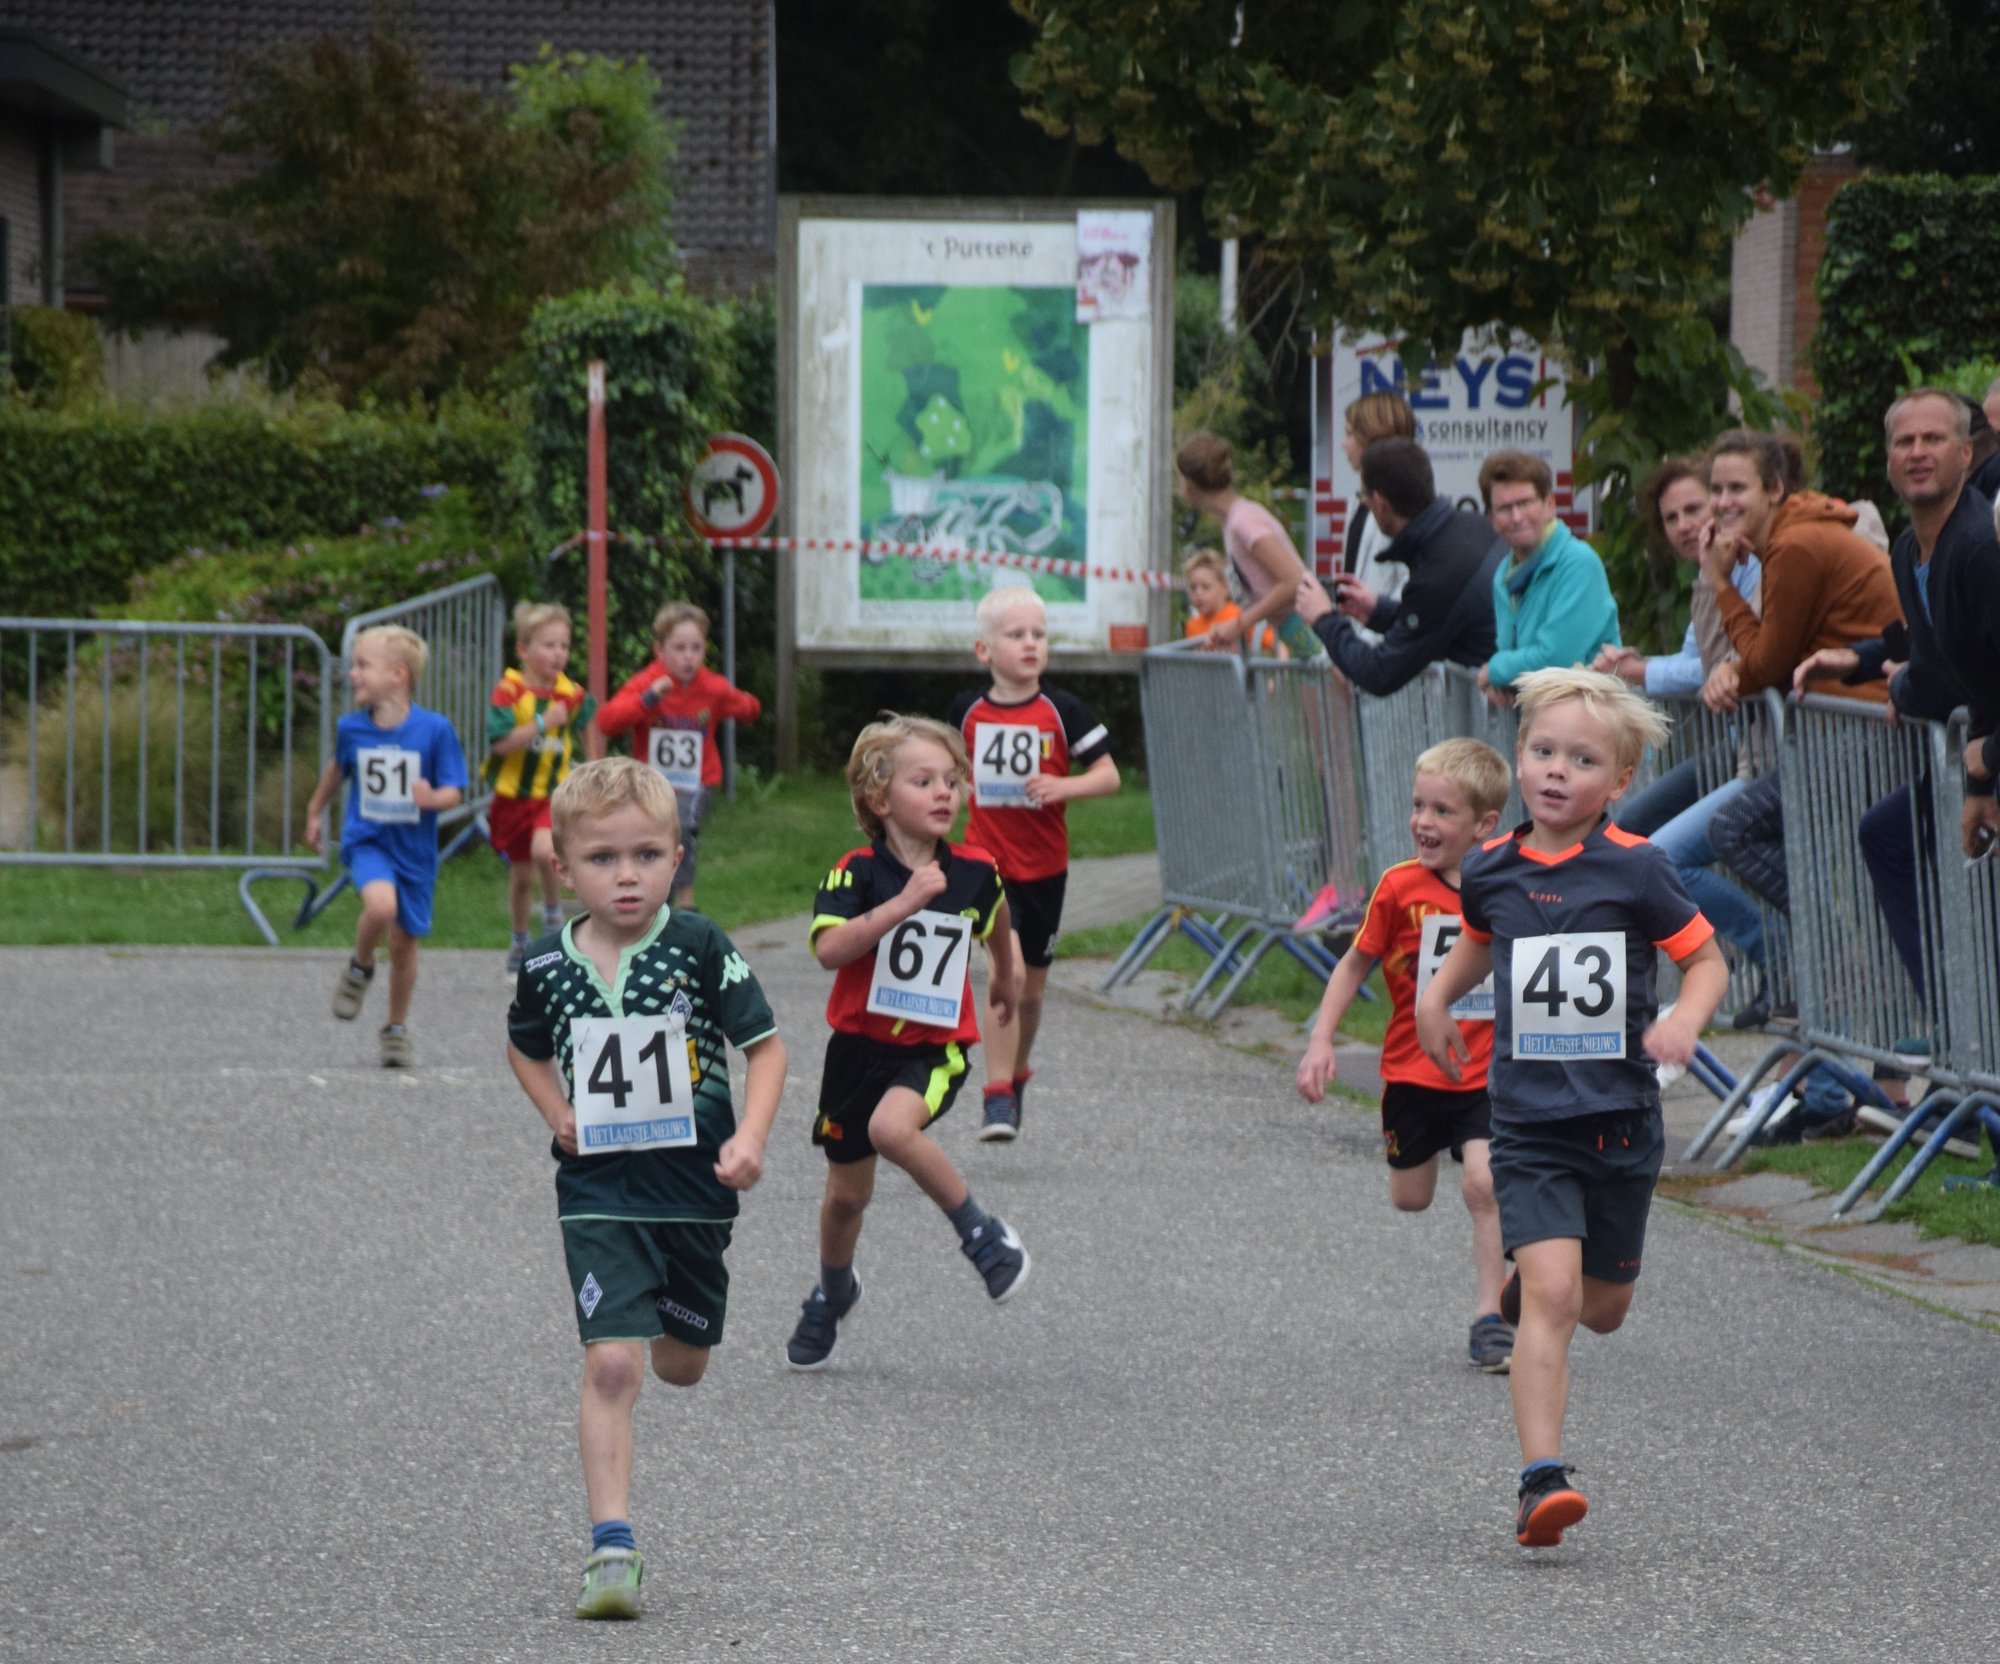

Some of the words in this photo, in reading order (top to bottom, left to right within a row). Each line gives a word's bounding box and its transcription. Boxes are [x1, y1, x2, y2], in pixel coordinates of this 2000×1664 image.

[1361, 355, 1534, 408] NEYS
[1428, 416, 1549, 440] consultancy
[657, 734, 697, 769] 63
[983, 730, 1032, 776] 48
[366, 757, 406, 796] 51
[889, 920, 963, 986] 67
[1523, 945, 1615, 1017] 43
[588, 1030, 672, 1108] 41
